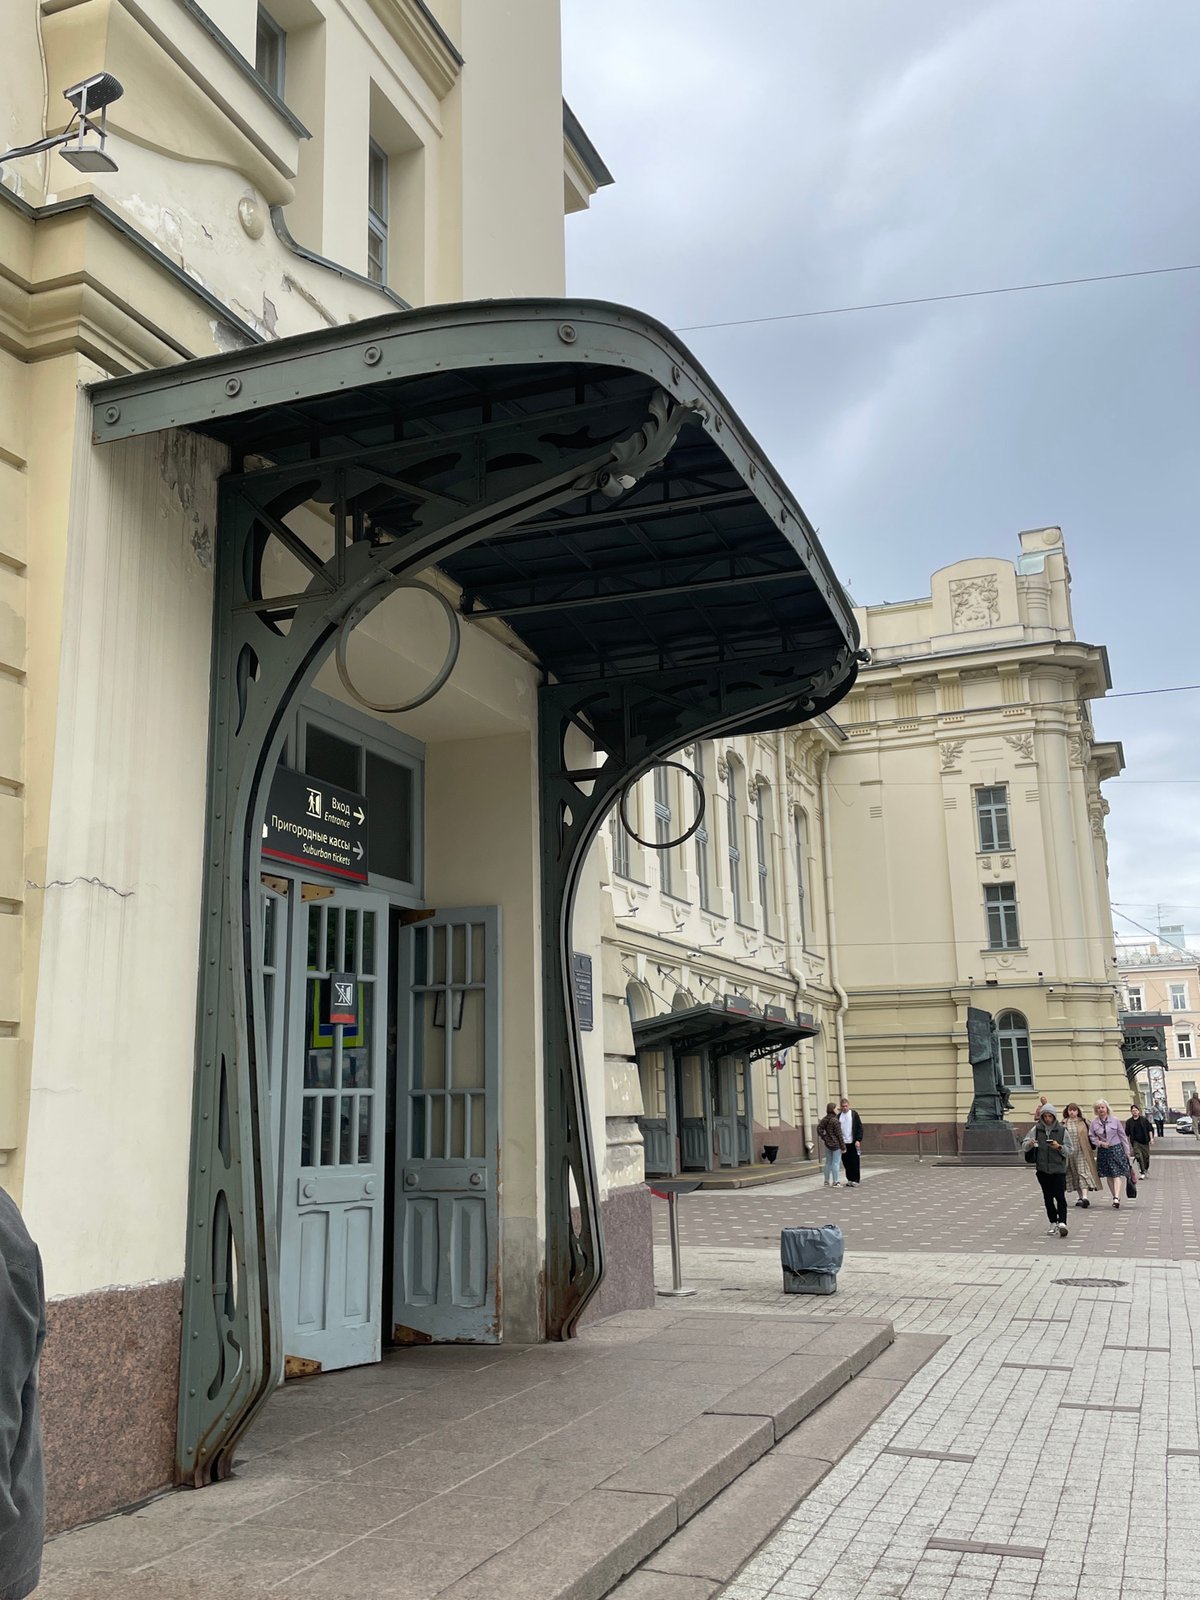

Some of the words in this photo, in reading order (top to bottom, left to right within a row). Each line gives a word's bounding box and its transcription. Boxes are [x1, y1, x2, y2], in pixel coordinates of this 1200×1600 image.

[332, 797, 350, 816] Вход
[324, 812, 350, 828] Entrance
[272, 815, 327, 843] Пригородные
[329, 836, 350, 850] кассы
[303, 843, 331, 860] Suburban
[333, 852, 350, 865] tickets
